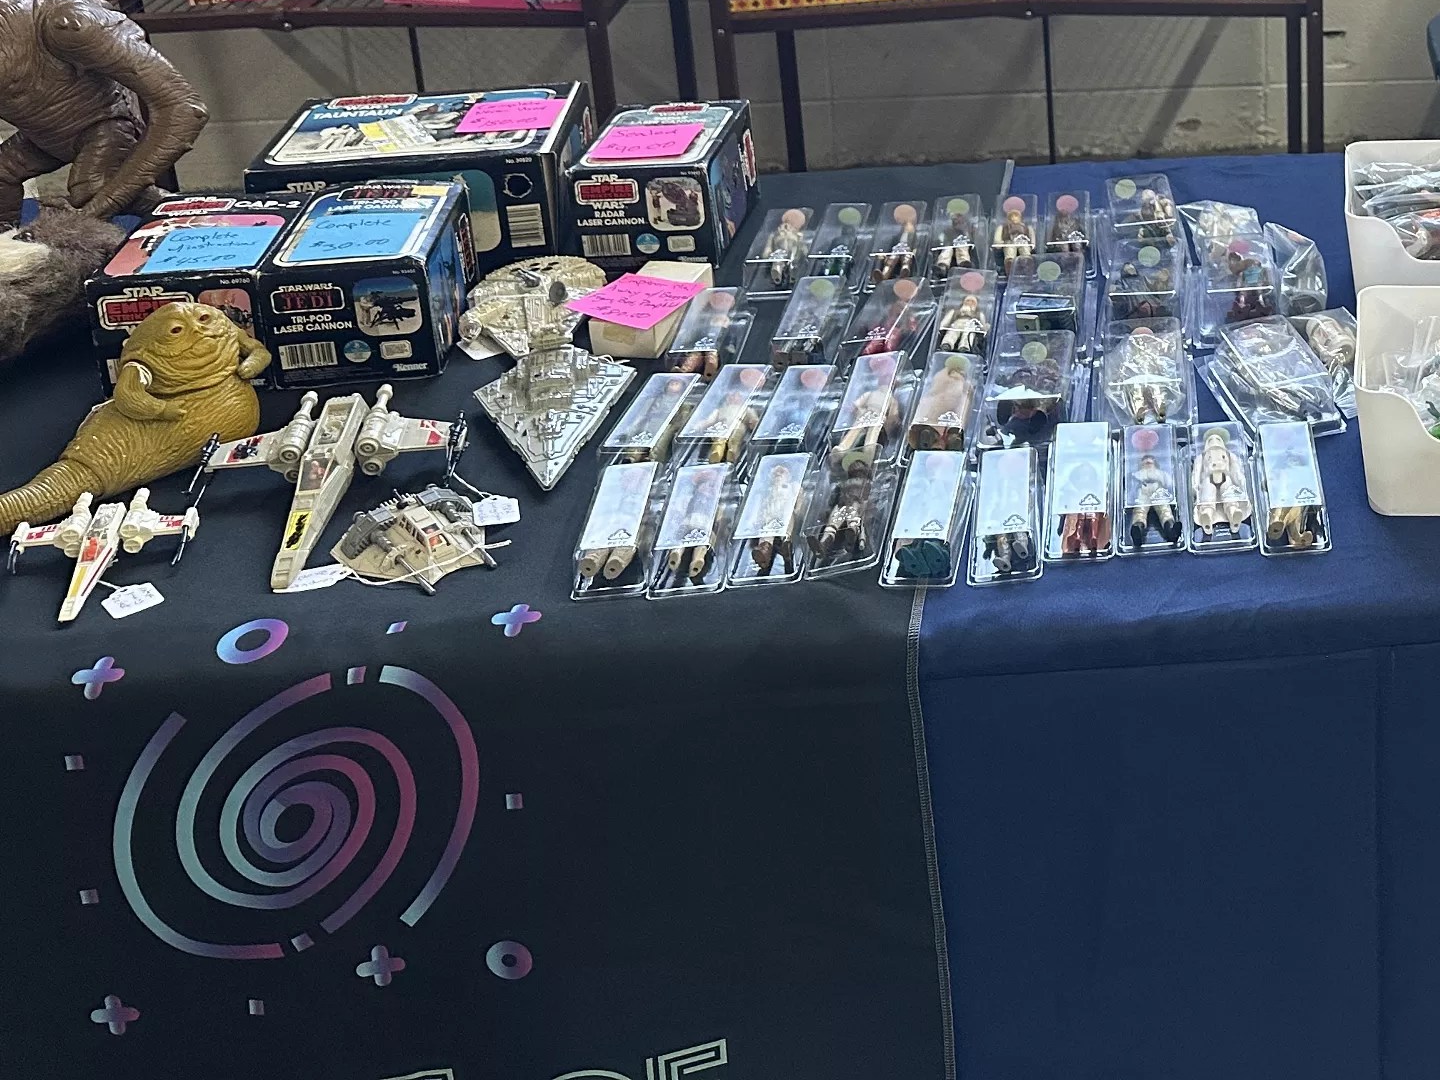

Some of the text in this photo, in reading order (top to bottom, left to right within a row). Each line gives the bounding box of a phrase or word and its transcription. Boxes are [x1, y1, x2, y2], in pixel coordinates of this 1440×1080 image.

[313, 108, 404, 120] TAUNTAUN
[612, 129, 678, 138] Sealed
[601, 141, 676, 154] $90.00
[591, 174, 619, 182] STAR
[286, 181, 327, 193] STAR
[581, 184, 633, 194] EMPIRE
[234, 200, 301, 209] CAP-2
[591, 201, 625, 210] WARS
[594, 210, 625, 219] RADAR
[316, 219, 391, 230] Complete
[577, 217, 645, 227] LASER CANNON
[170, 231, 240, 243] Complete
[309, 238, 390, 252] $30.00
[156, 254, 236, 267] $45.00
[123, 286, 164, 297] STAR
[278, 282, 333, 292] STAR WARS
[282, 294, 333, 310] JEDI
[291, 314, 332, 324] TRI-POD
[274, 321, 352, 334] LASER CANNON
[393, 363, 428, 371] Kenner
